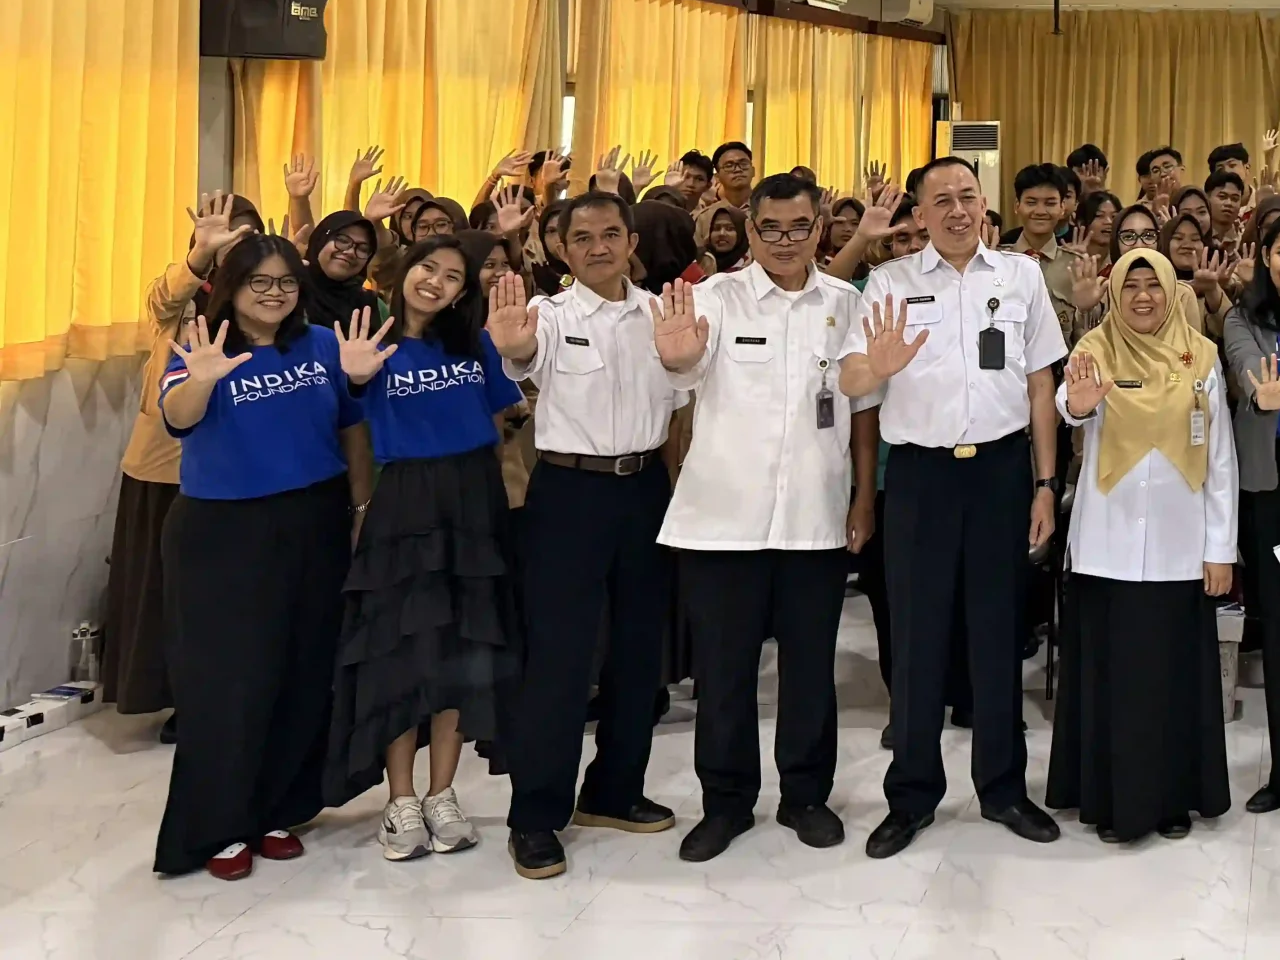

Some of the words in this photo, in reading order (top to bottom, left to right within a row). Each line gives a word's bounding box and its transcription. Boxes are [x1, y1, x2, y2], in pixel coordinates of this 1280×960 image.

[229, 360, 328, 396] INDIKA
[386, 360, 485, 389] INDIKA
[386, 373, 486, 399] FOUNDATION
[233, 375, 331, 407] FOUNDATION
